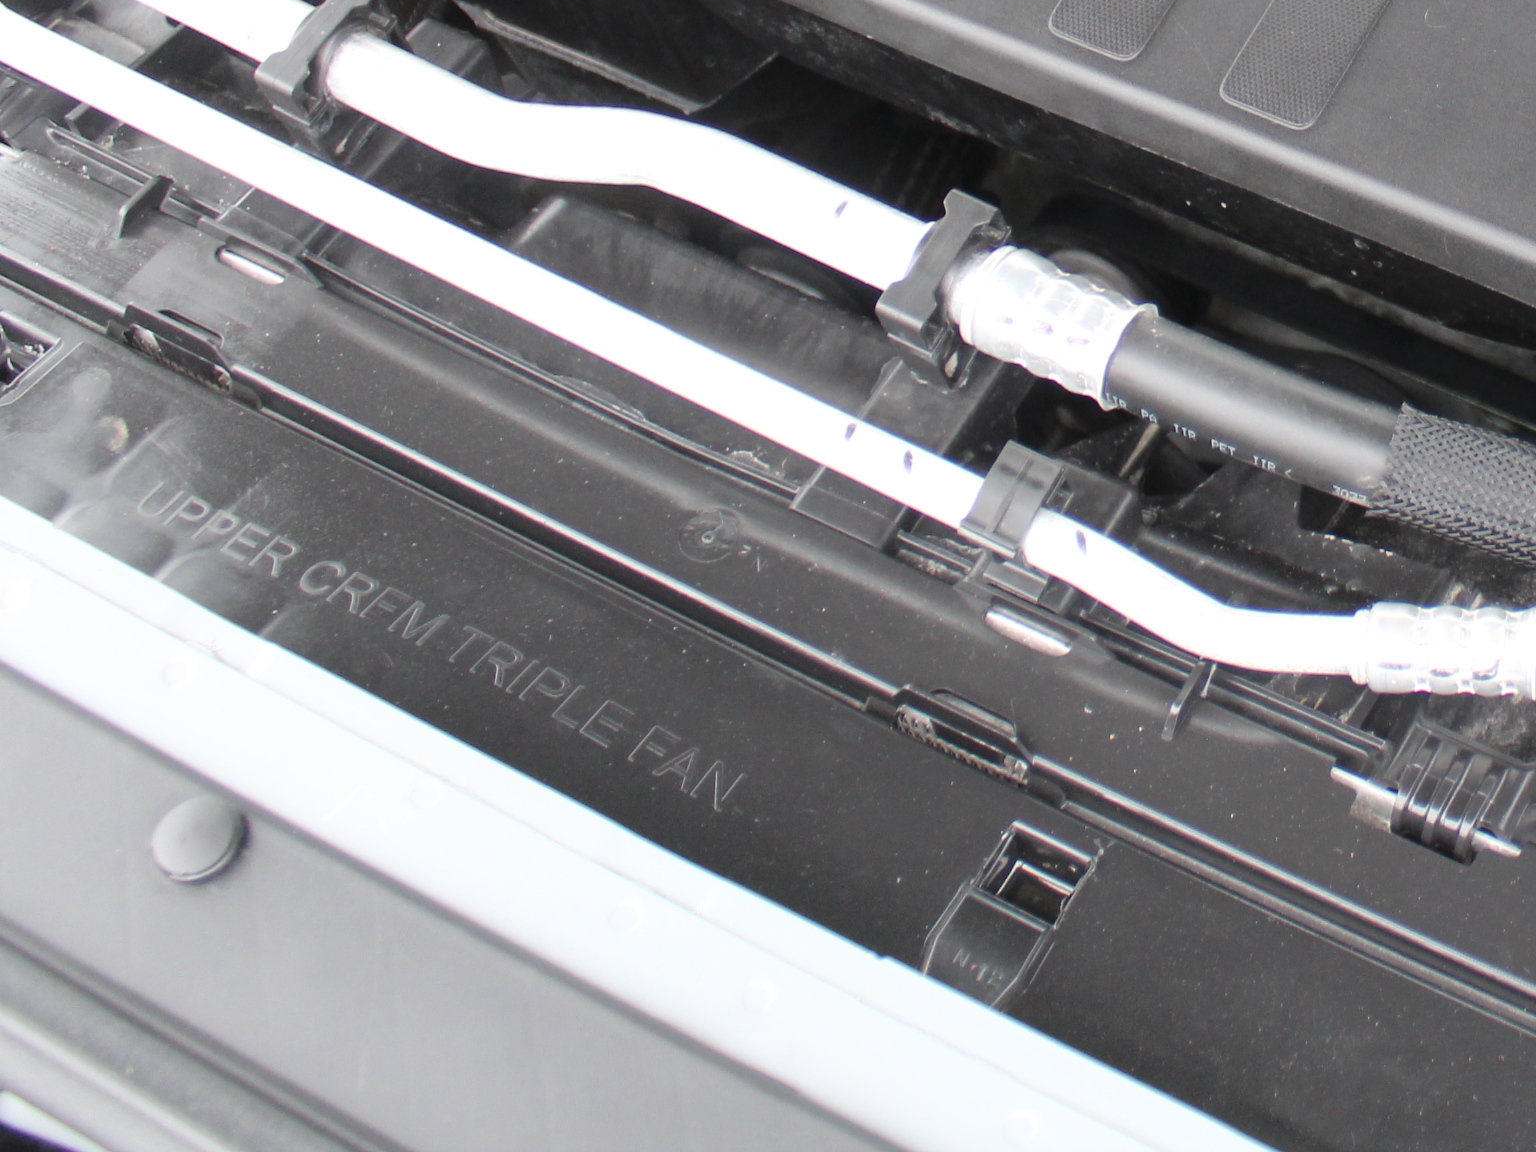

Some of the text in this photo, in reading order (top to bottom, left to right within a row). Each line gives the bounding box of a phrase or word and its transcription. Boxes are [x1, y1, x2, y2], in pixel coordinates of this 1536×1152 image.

[1173, 423, 1198, 441] IIR
[1210, 437, 1237, 457] PET
[1251, 453, 1278, 472] IIR
[135, 478, 748, 814] UPPER CRFM TRIPLE FAN
